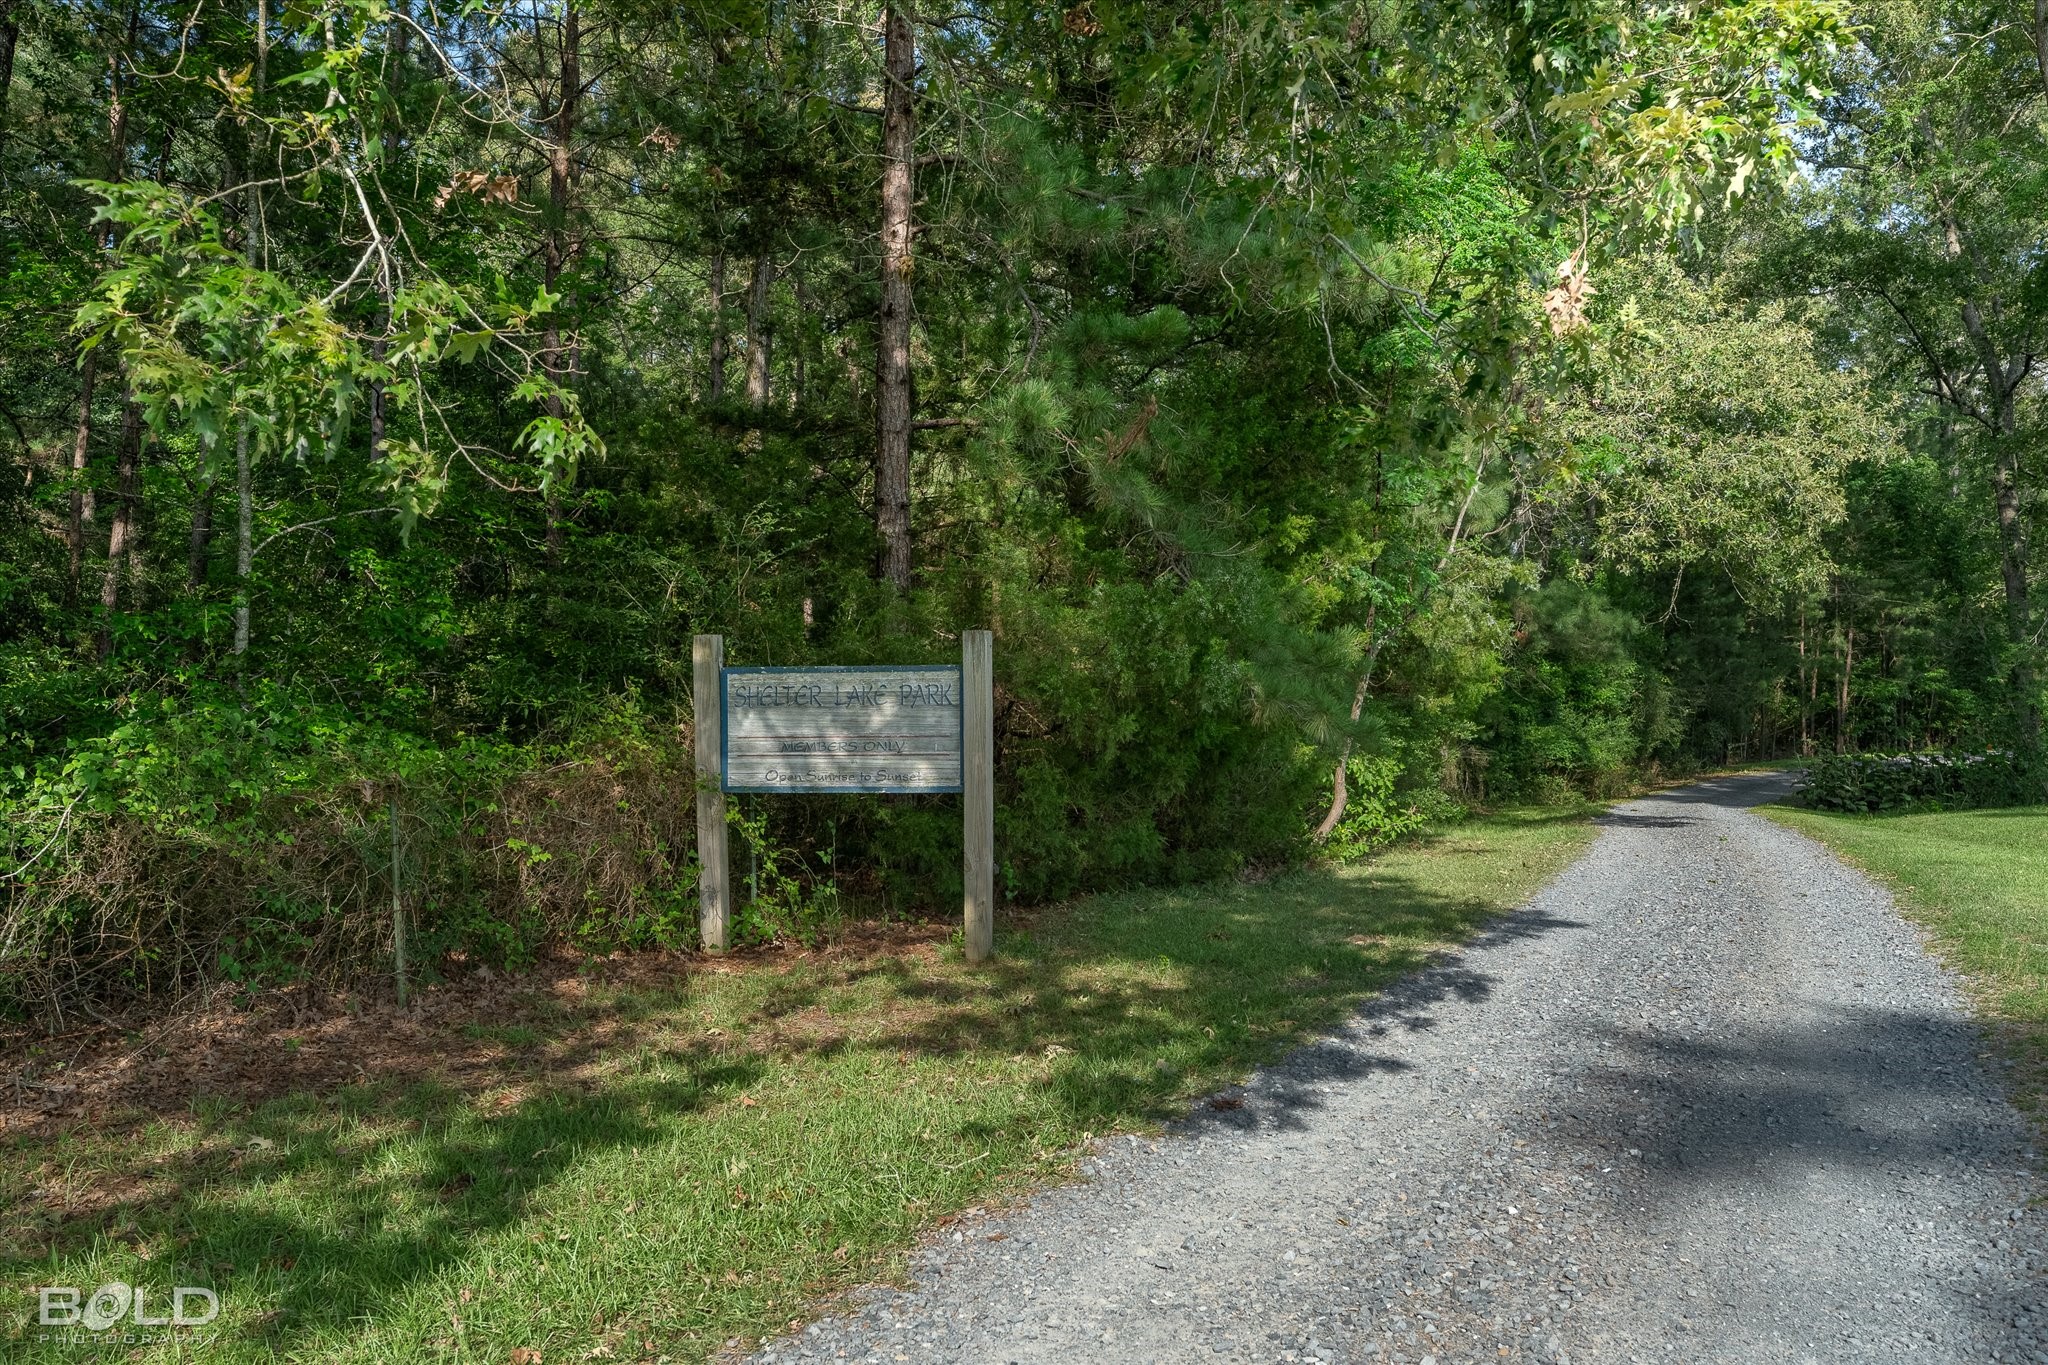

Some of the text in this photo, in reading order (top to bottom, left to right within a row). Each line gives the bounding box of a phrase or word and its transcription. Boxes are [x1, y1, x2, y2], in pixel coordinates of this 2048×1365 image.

[734, 683, 954, 708] SHELTER LAKE PARK
[781, 740, 905, 753] MEMBERS ONLY
[765, 769, 922, 784] Open Sunrise to Sunset
